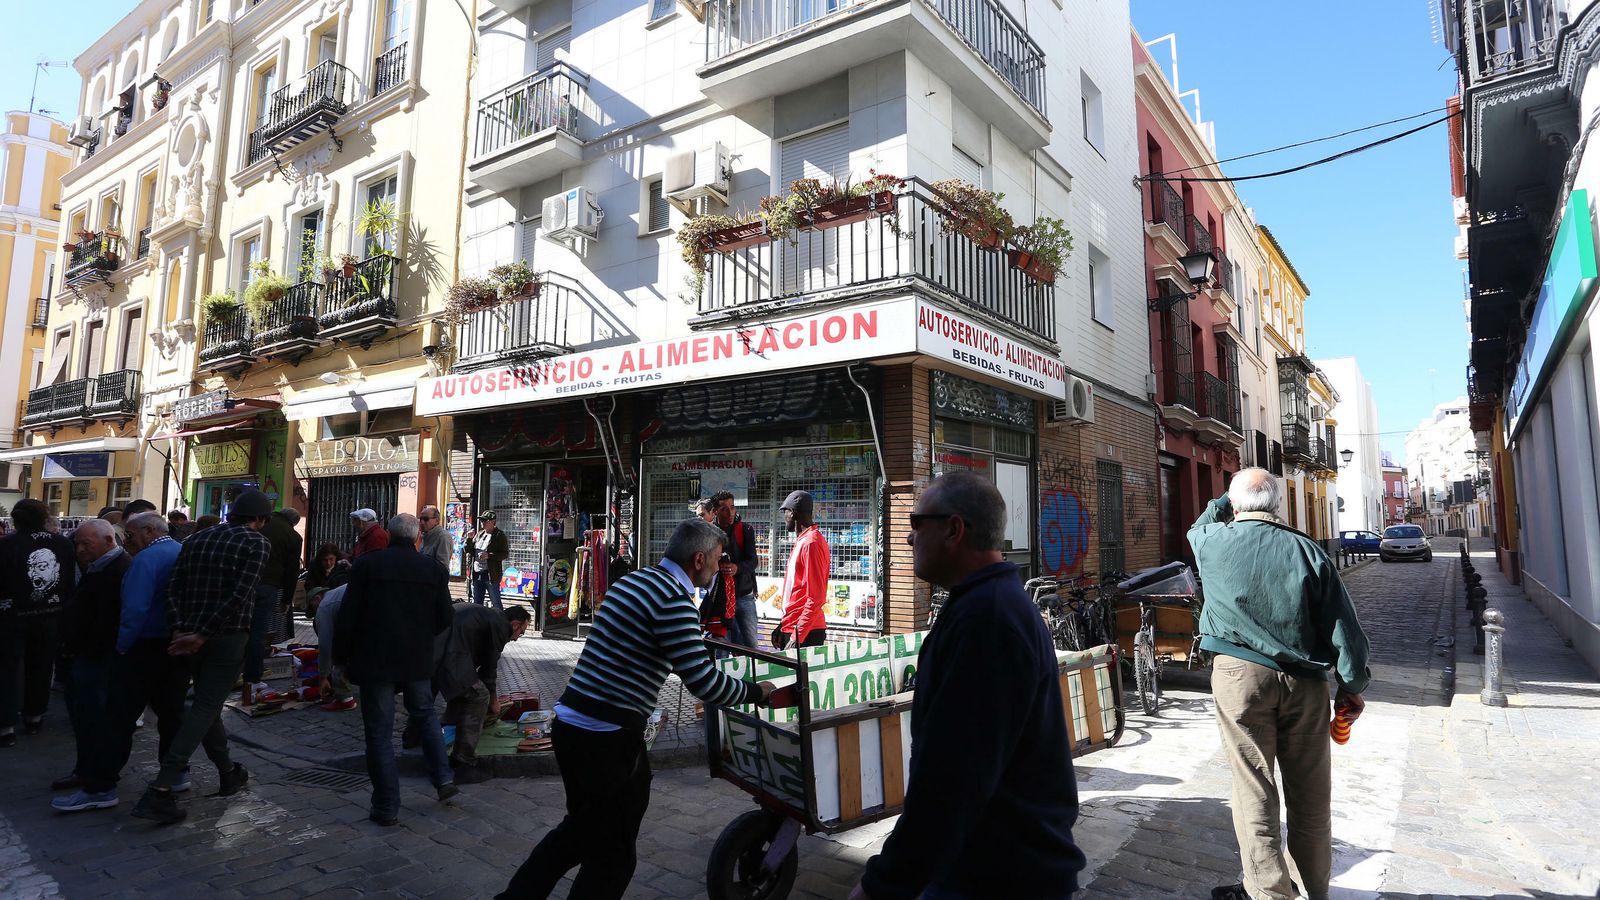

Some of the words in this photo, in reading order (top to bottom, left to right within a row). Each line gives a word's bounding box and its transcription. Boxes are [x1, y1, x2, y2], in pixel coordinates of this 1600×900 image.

[432, 357, 593, 399] AUTOSERVICIO
[618, 310, 878, 375] ALIMENTACION
[1005, 342, 1065, 384] ALIMENTACION
[555, 378, 603, 394] BEBIDAS
[613, 372, 662, 386] FRUTAS
[1008, 369, 1045, 390] FRUTAS
[333, 434, 409, 464] BODEGA
[353, 465, 367, 473] DE
[374, 462, 409, 471] VINOS
[671, 459, 753, 471] ALIMENTACION
